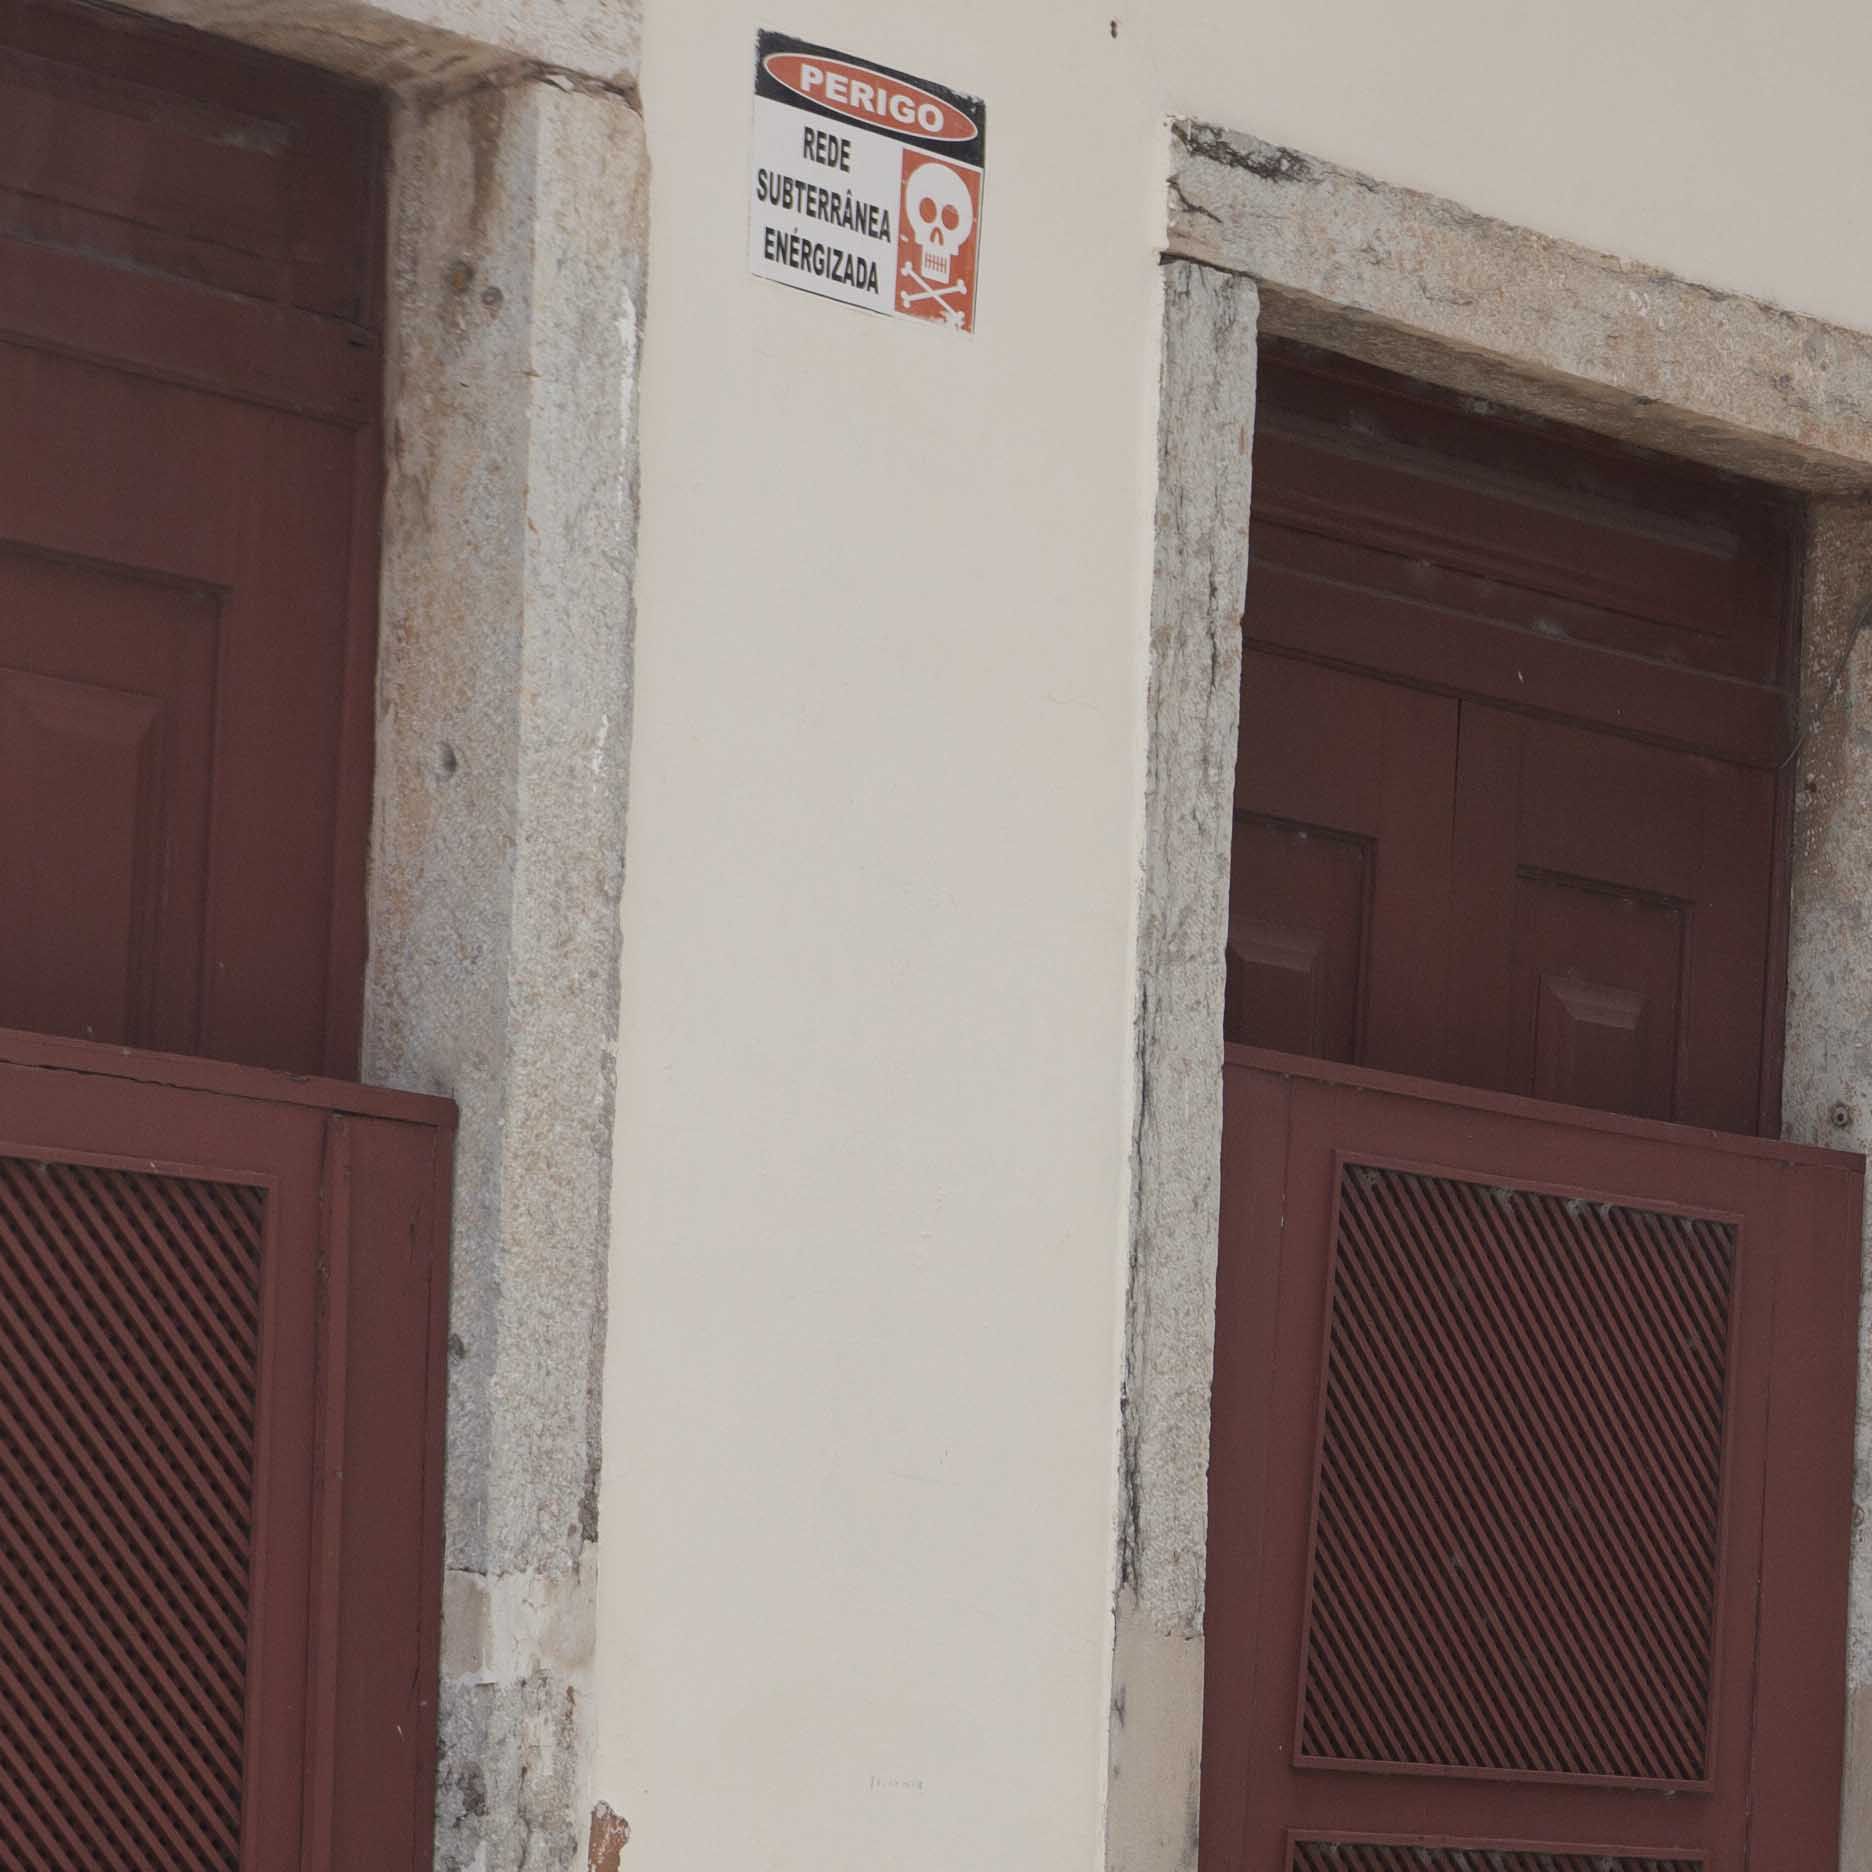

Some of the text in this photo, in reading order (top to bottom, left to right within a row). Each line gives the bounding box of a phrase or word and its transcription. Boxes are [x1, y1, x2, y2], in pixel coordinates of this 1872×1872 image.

[800, 62, 945, 133] PERIGO
[803, 126, 851, 173] REDE
[756, 167, 892, 243] SUBTERRÂNEA
